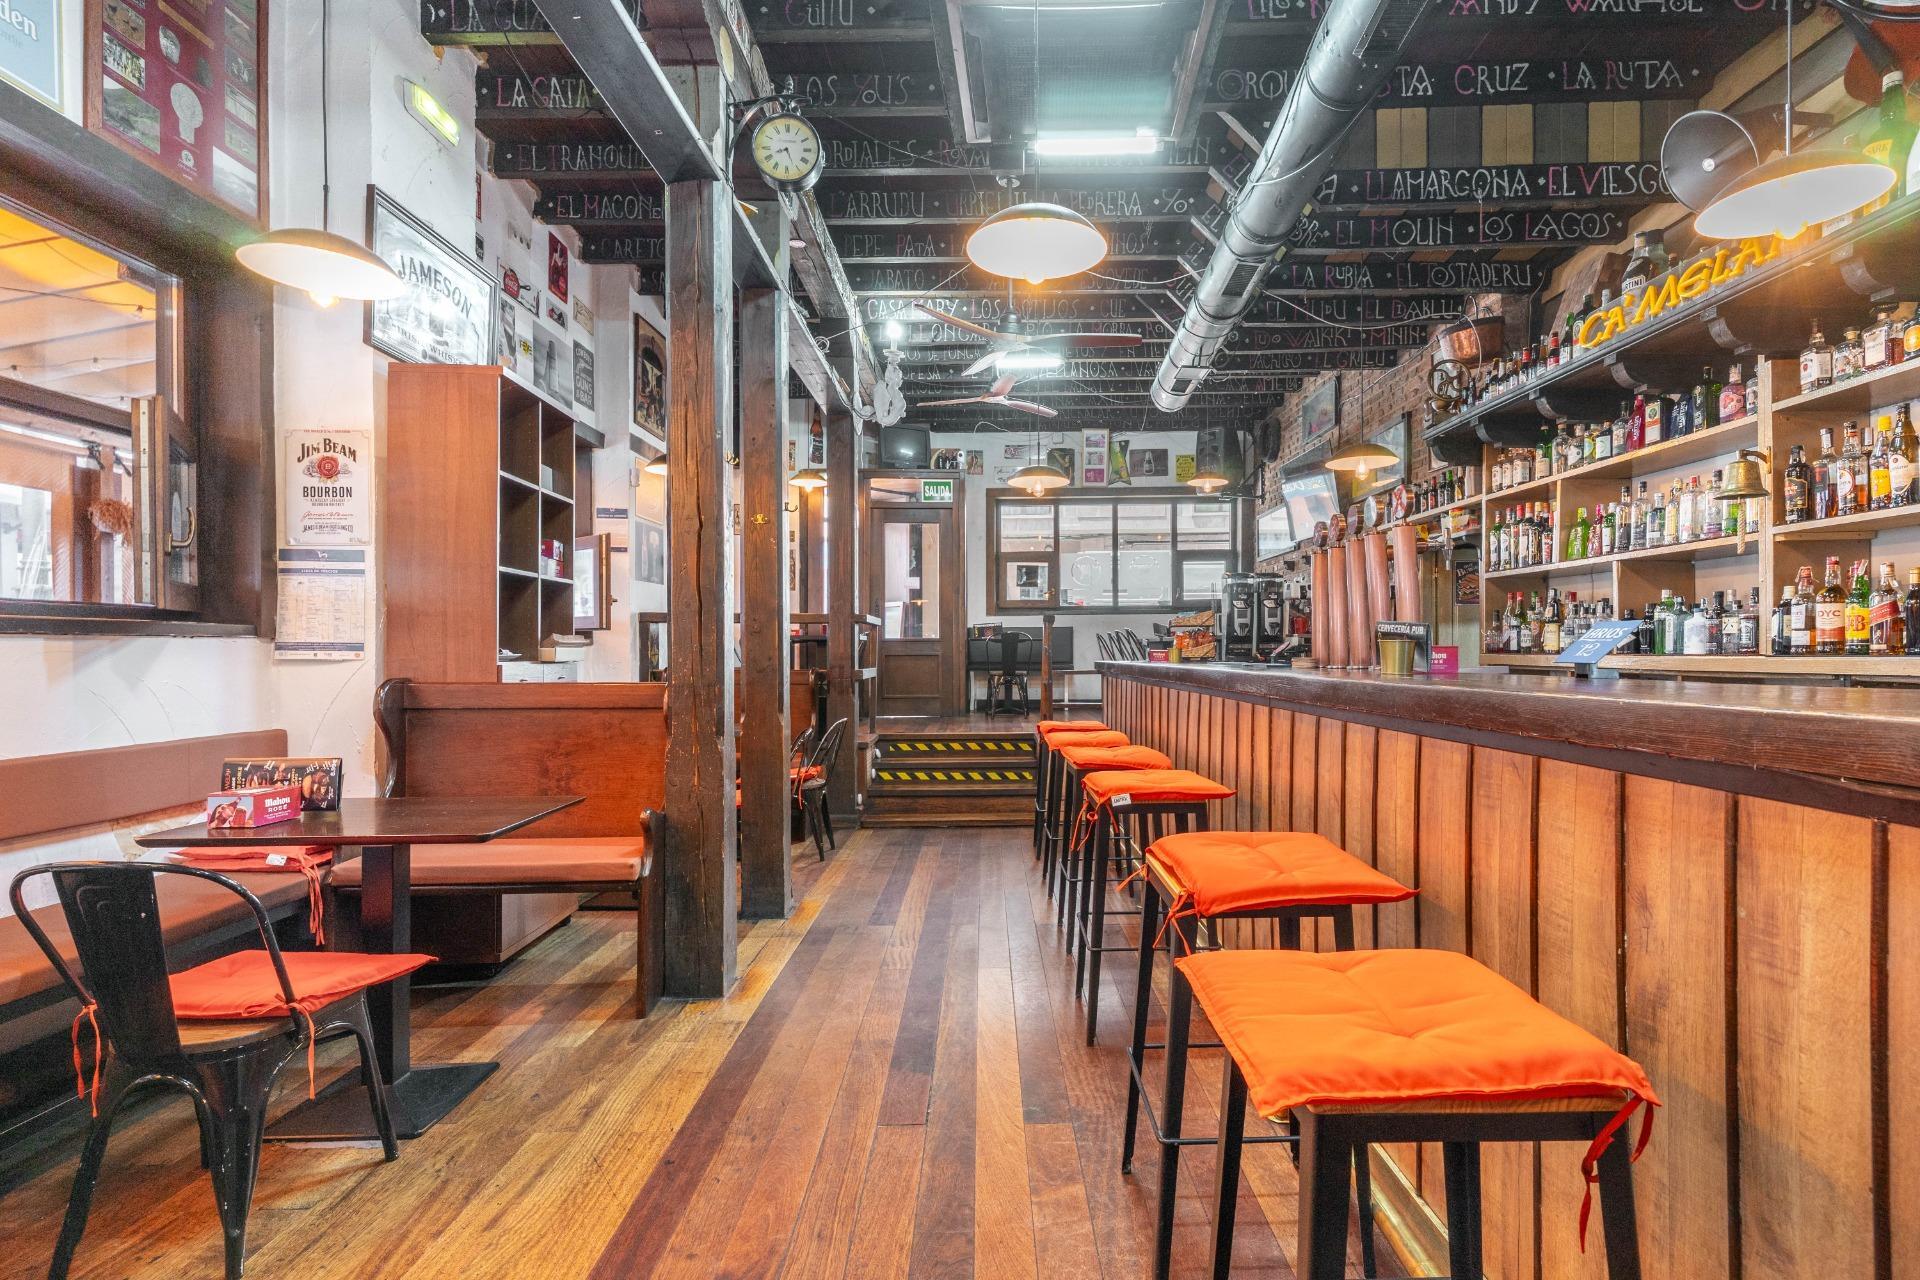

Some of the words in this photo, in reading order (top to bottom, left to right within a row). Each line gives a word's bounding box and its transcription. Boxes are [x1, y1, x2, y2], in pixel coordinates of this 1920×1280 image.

[1454, 63, 1531, 96] CRUZ
[1561, 61, 1597, 90] LA
[1604, 60, 1685, 90] RUTA
[496, 77, 526, 108] LA
[531, 76, 592, 108] GATA
[518, 143, 546, 171] EL
[1547, 165, 1576, 196] EL
[556, 194, 582, 219] EL
[1336, 219, 1361, 246] EL
[1370, 216, 1454, 247] MOLIN
[1479, 213, 1515, 242] LOS
[1525, 211, 1616, 241] LAGOS
[1292, 264, 1317, 288] LA
[1324, 264, 1375, 288] RUBIA
[1396, 262, 1419, 287] EL
[1419, 262, 1533, 288] TOSTADERU
[1624, 277, 1646, 290] RTINI
[397, 255, 473, 319] JAMESON
[970, 299, 1001, 320] LOS
[1366, 300, 1385, 319] EL
[297, 442, 322, 463] JIM
[322, 438, 357, 462] BEAM
[302, 486, 353, 498] BOURBON
[924, 485, 952, 498] SALIDA
[1817, 609, 1841, 617] DYC
[1377, 623, 1411, 634] CERVECERÍA
[1411, 625, 1425, 635] PUB
[1581, 627, 1628, 639] LARIOS
[264, 796, 291, 808] Mahou
